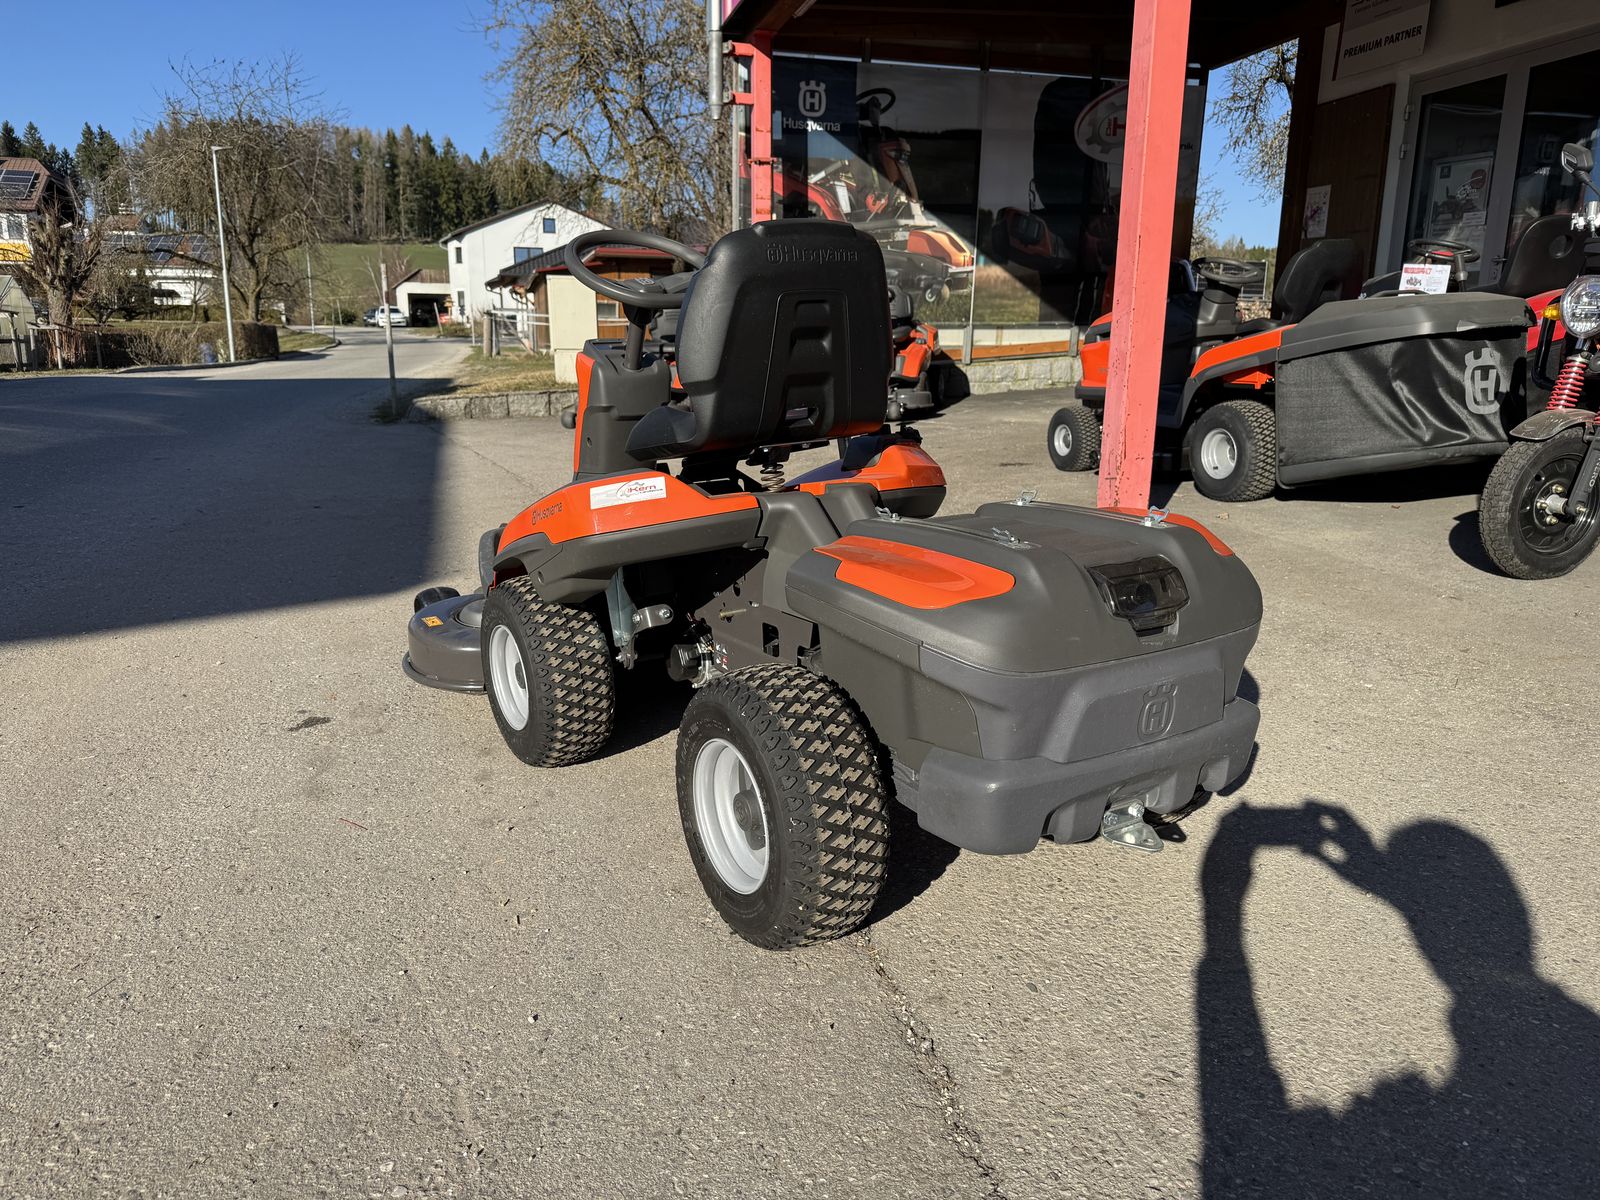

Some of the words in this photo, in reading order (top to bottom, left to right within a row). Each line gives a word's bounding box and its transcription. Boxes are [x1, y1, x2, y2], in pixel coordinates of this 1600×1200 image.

[1343, 38, 1382, 59] PREMIUM
[1384, 25, 1423, 46] PARTNER
[783, 117, 841, 132] Husqvarna
[784, 244, 860, 265] Husqvarna
[536, 502, 562, 521] Husqvarna
